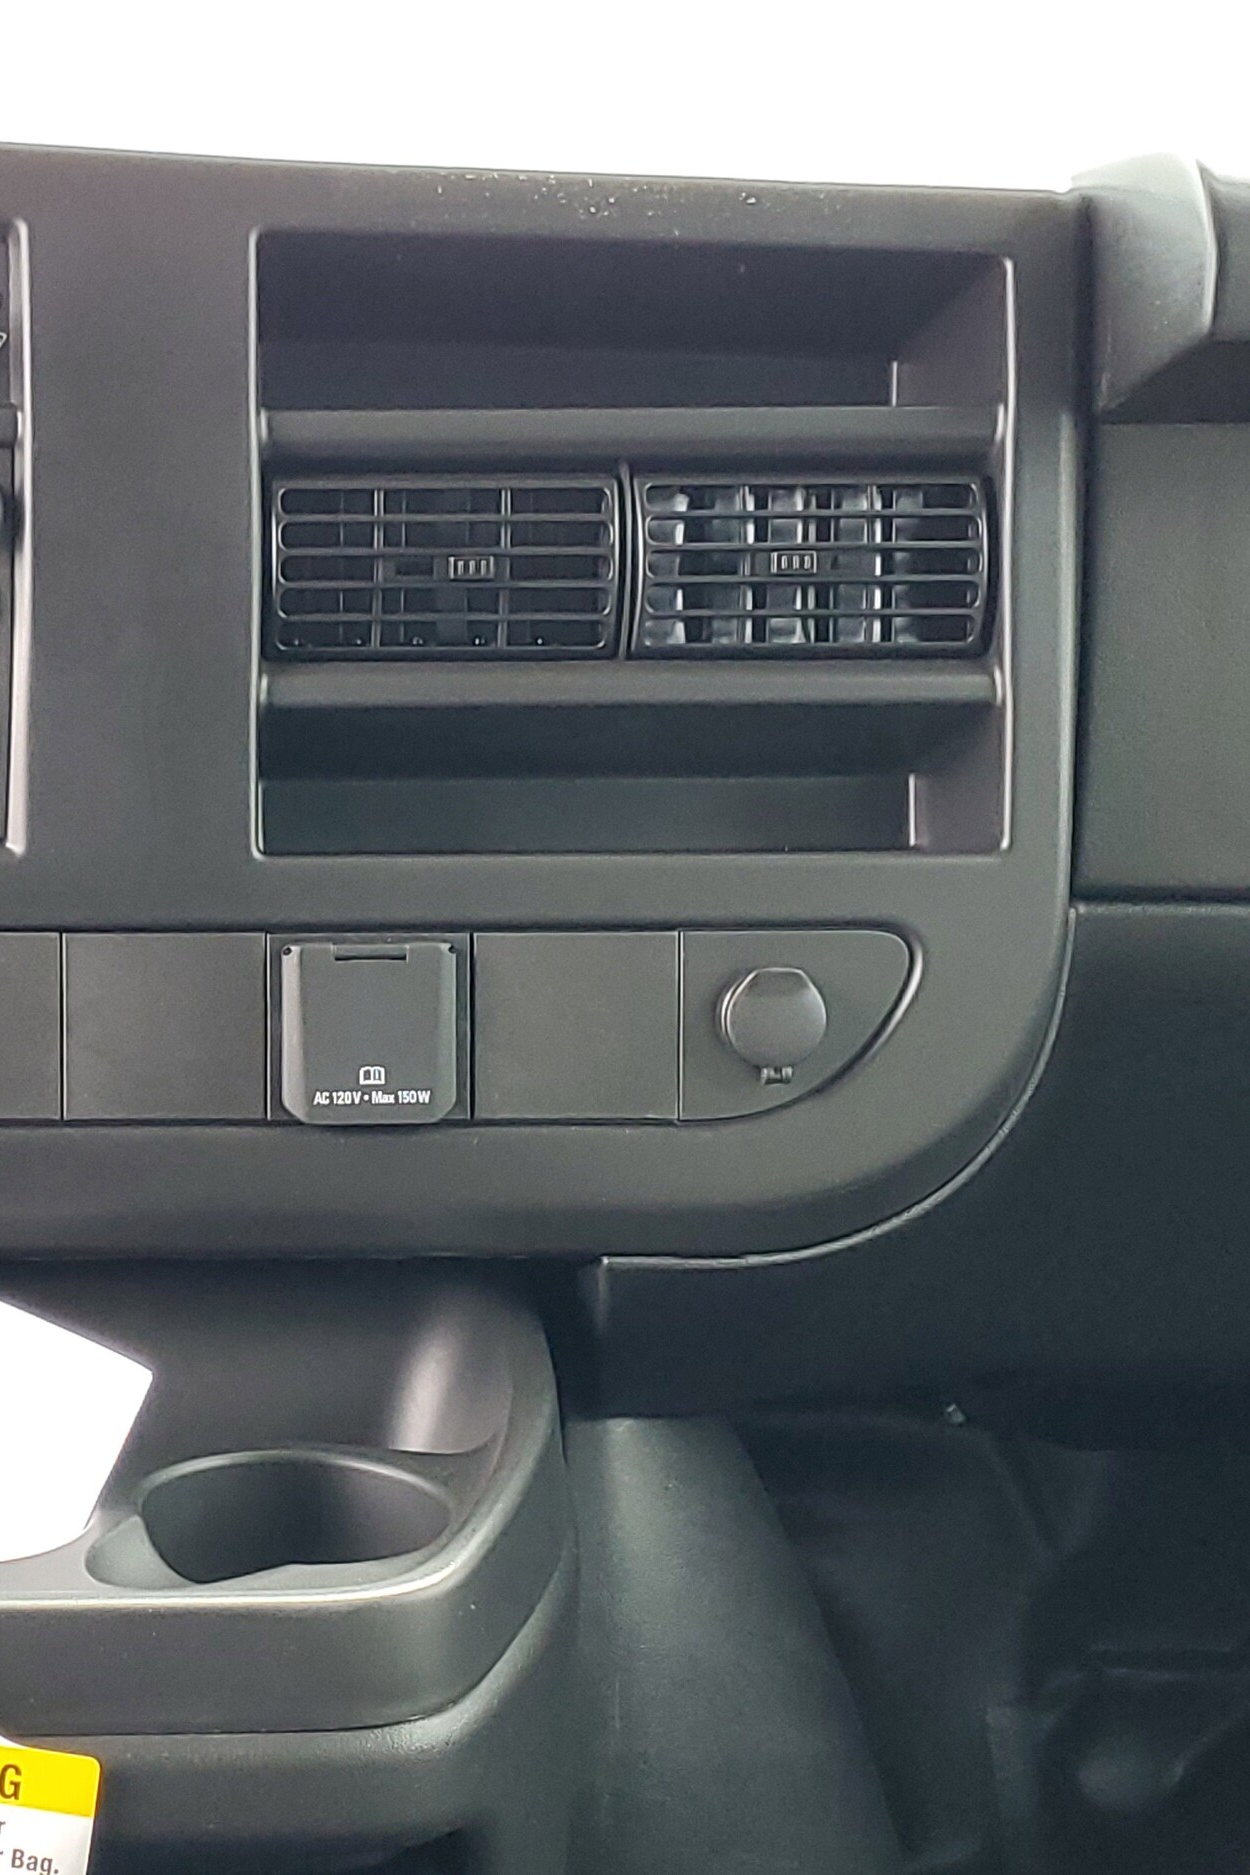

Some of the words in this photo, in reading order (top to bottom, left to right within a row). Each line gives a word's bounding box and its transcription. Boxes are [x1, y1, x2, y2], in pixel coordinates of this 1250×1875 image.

[313, 1090, 330, 1106] AC
[371, 1090, 395, 1105] Max
[11, 1848, 59, 1875] Bag.
